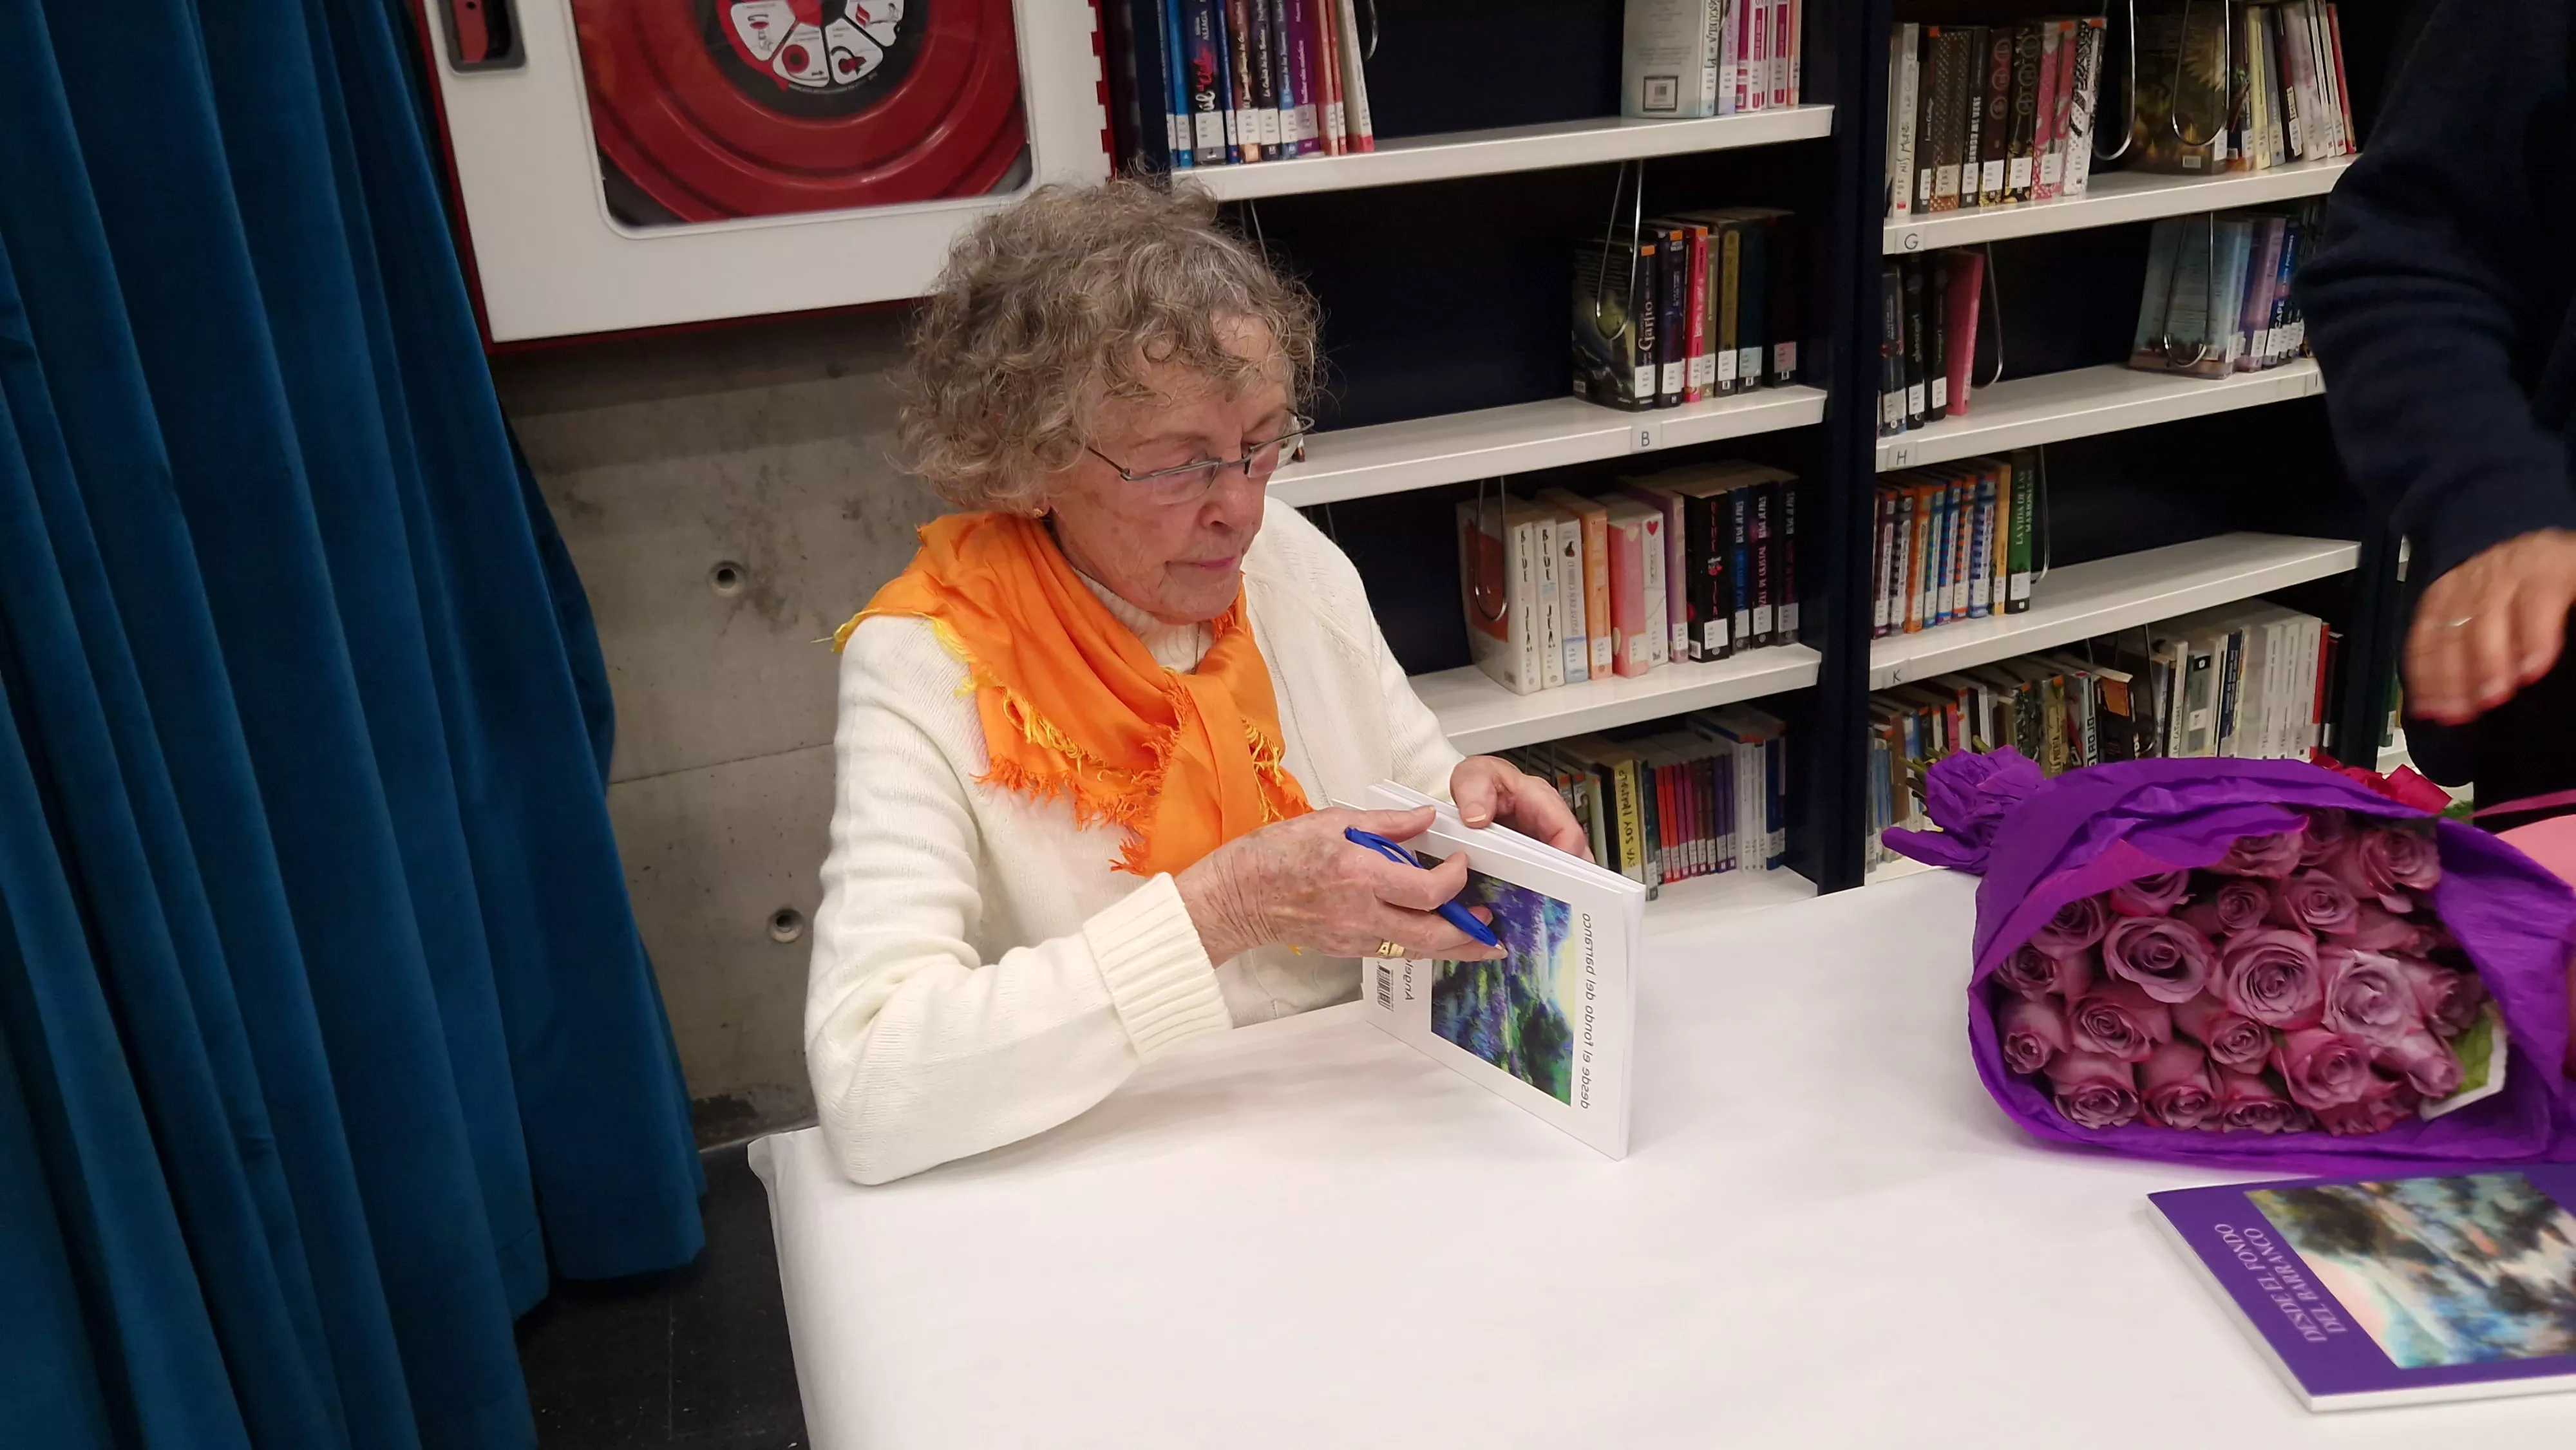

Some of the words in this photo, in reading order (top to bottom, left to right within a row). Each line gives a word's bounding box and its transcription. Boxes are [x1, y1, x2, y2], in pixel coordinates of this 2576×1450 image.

[1904, 232, 1918, 250] G
[1640, 431, 1650, 447] B
[1896, 449, 1908, 465] H
[1893, 669, 1901, 683] K
[2087, 715, 2096, 753] ROJO
[1623, 822, 1633, 843] SOY
[2214, 1223, 2266, 1270] FONDO
[2244, 1228, 2319, 1301] BARRANCO
[2257, 1272, 2284, 1290] EL
[2270, 1293, 2327, 1341] DESDE
[2310, 1303, 2347, 1332] DEL
